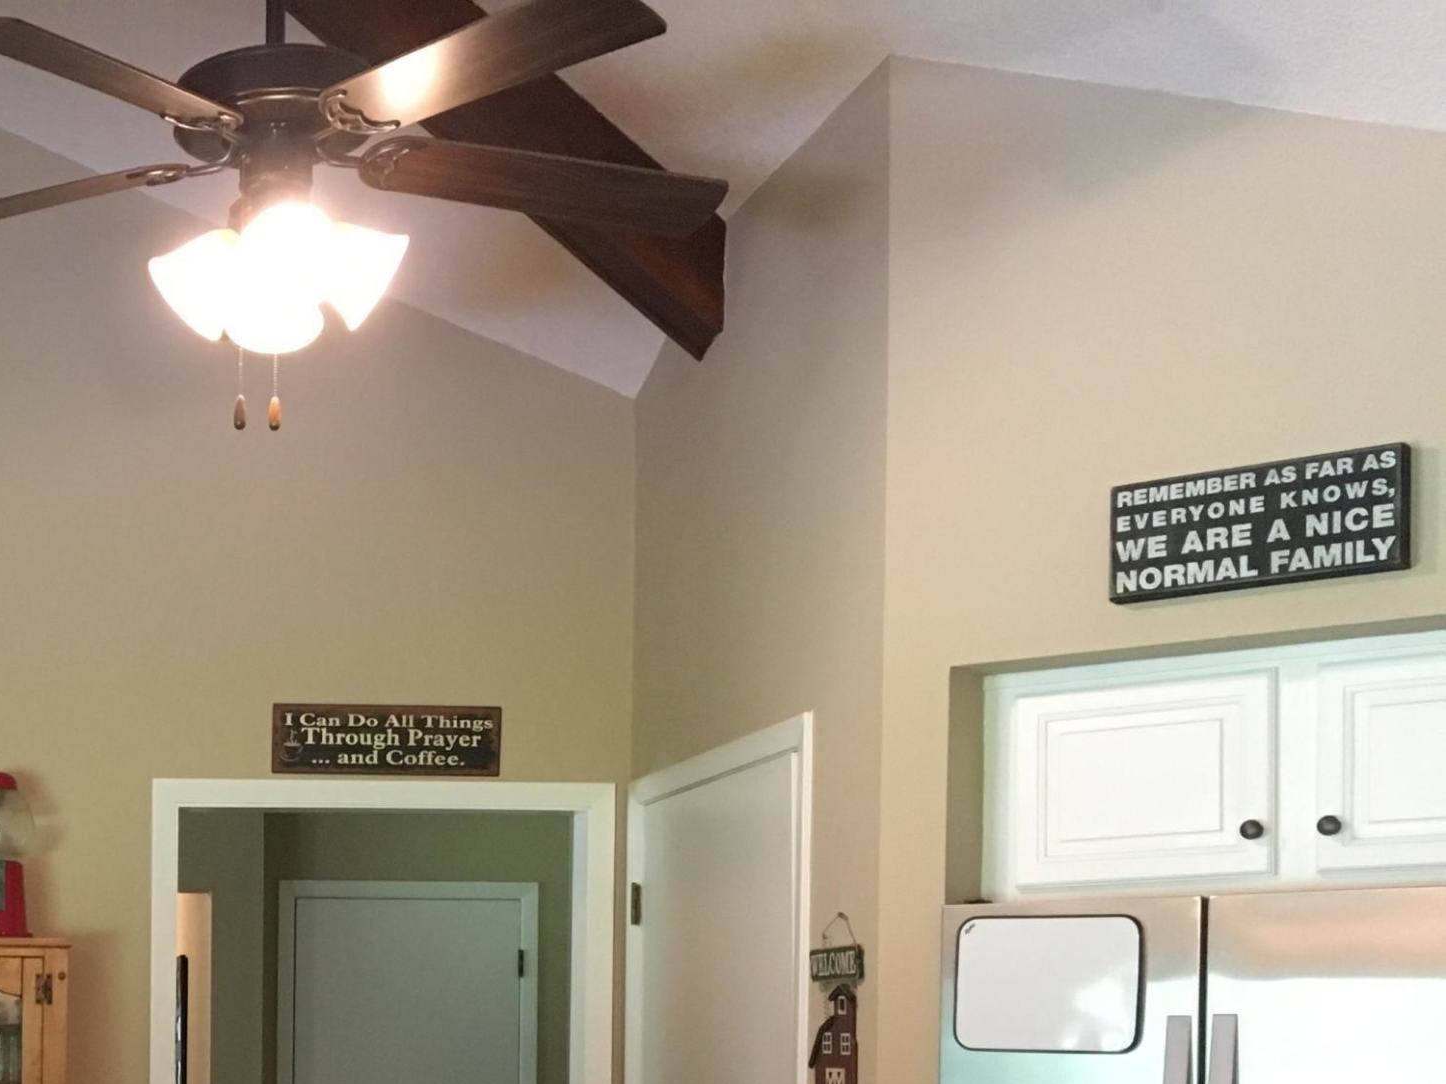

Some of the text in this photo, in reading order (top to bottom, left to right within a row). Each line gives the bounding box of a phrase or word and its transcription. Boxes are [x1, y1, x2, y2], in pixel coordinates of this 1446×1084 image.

[1116, 450, 1396, 508] REMEMBER AS FAR AS
[1116, 477, 1396, 533] EVERYONE KNOWS,
[1115, 503, 1395, 563] WE ARE A NICE
[1116, 535, 1396, 594] NORMAL FAMILY
[284, 712, 494, 732] I Can Do All Things
[301, 727, 481, 751] Through Prayer
[337, 750, 379, 765] and
[386, 750, 466, 766] Coffee.
[810, 950, 857, 976] WELCOME
